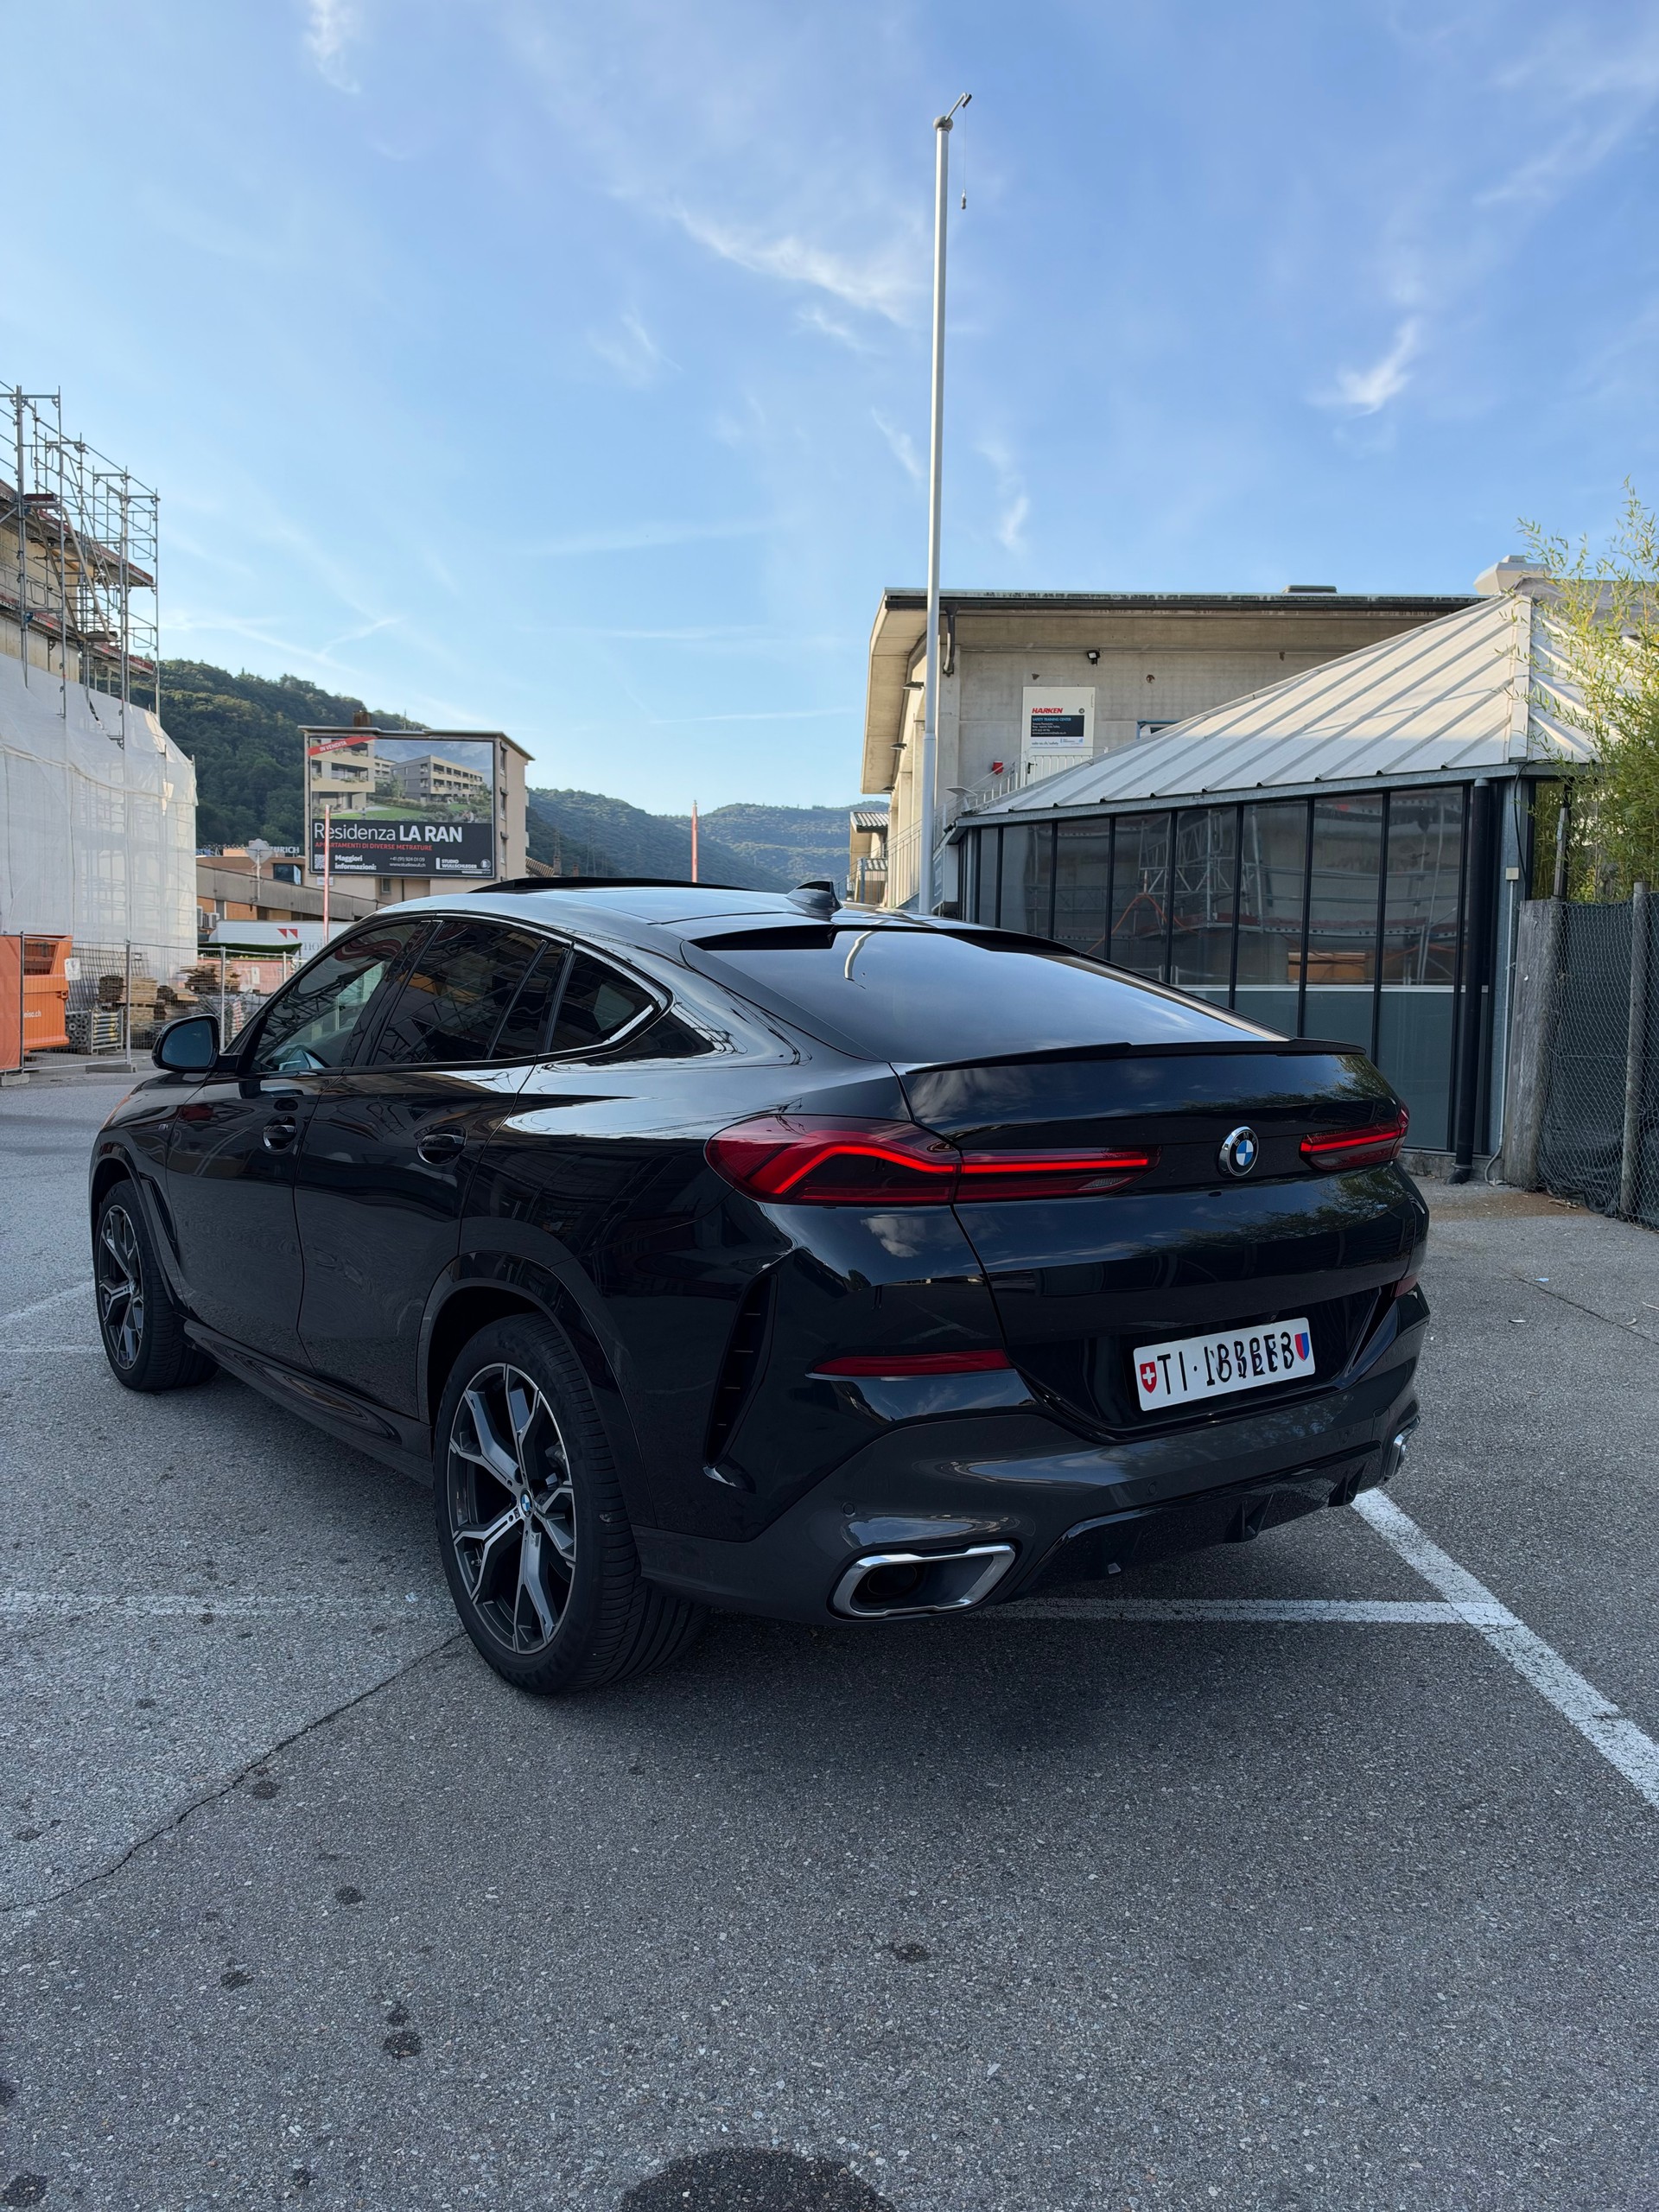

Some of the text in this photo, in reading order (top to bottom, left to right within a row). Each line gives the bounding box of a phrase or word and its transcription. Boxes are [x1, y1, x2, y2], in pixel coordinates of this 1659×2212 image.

[314, 823, 463, 843] Residenza LA RAN
[370, 842, 395, 851] DIVERSE
[334, 855, 363, 863] Maggiori
[1157, 1351, 1188, 1395] TI
